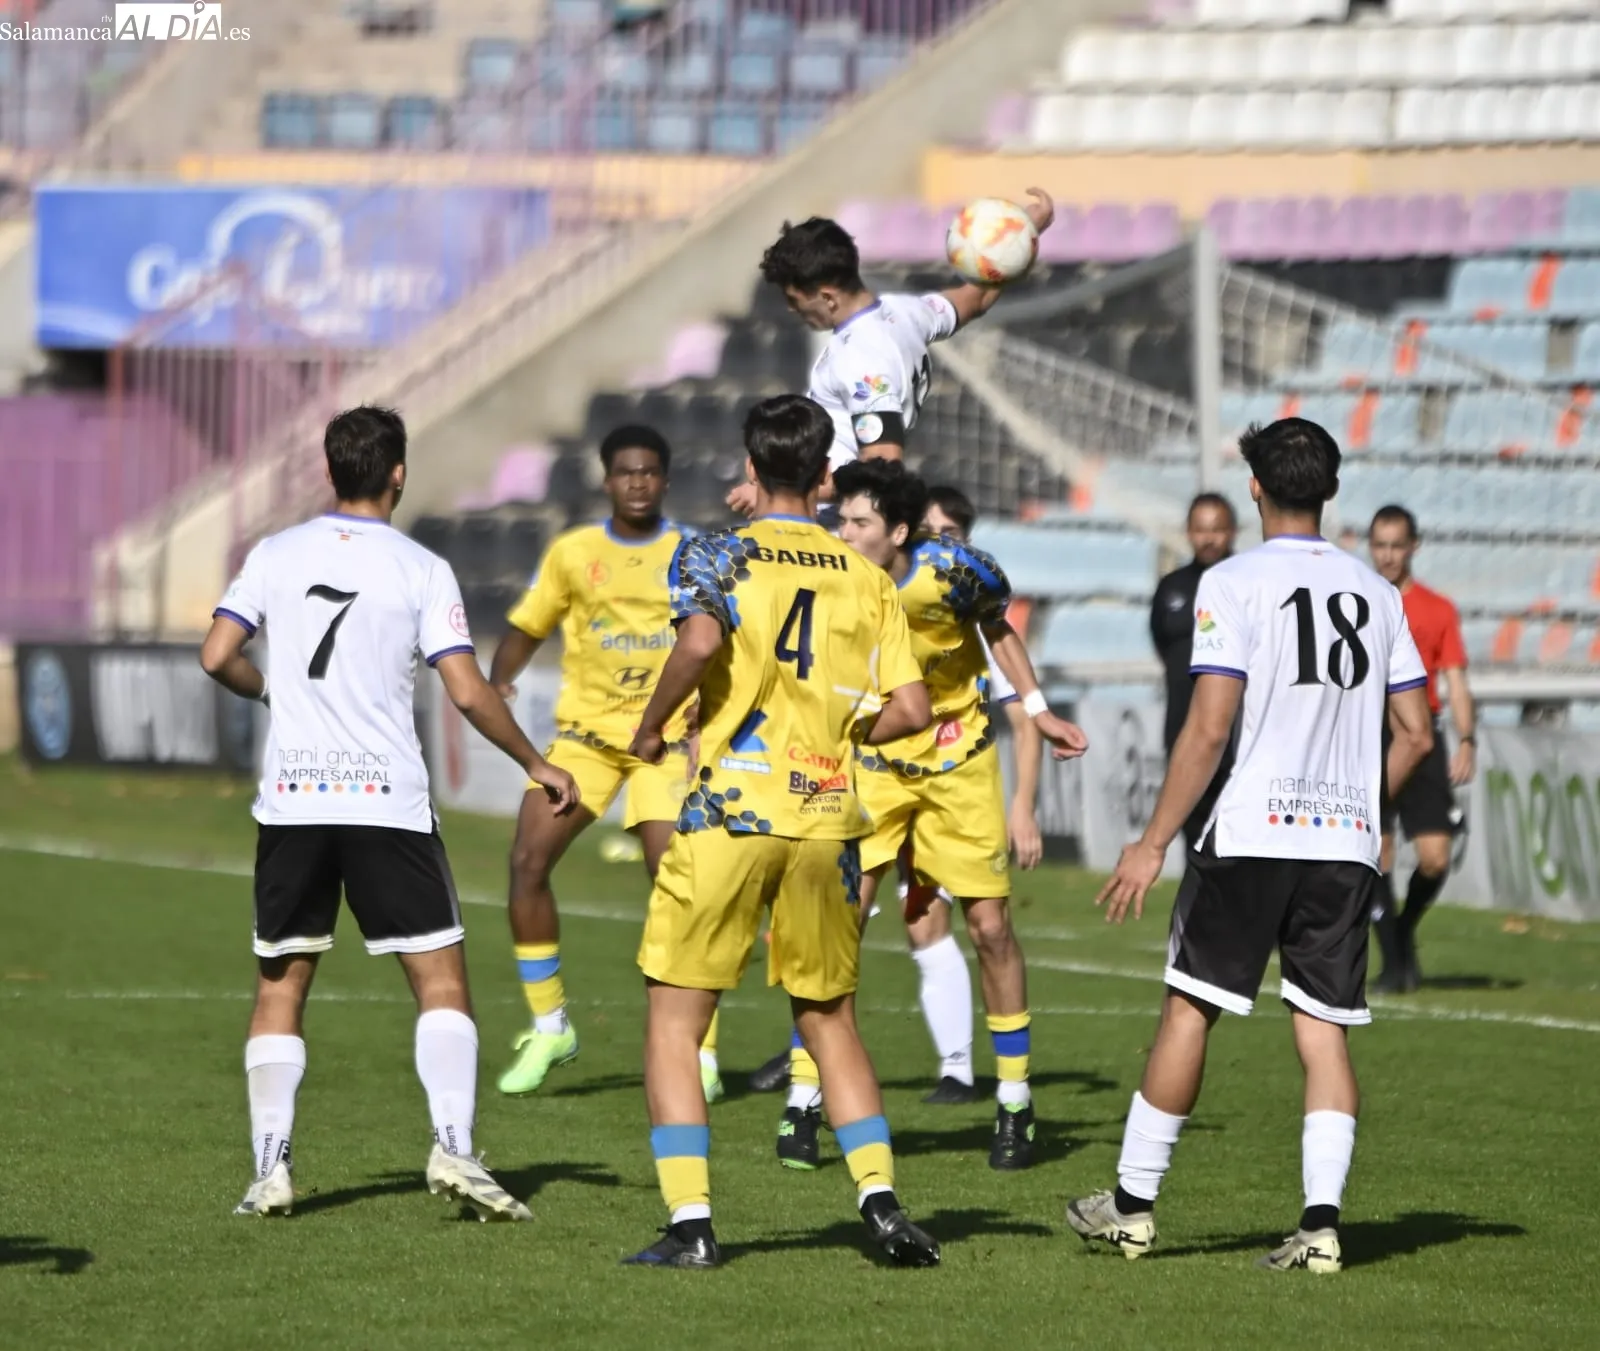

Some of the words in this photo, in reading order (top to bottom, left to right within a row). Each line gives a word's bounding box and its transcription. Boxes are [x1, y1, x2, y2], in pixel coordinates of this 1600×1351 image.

[756, 546, 849, 572] GABRI
[305, 583, 360, 680] 7
[774, 586, 817, 681] 4
[1279, 586, 1371, 691] 18
[326, 749, 391, 770] grupo
[278, 768, 392, 784] EMPRESARIAL
[1269, 774, 1312, 795] nani
